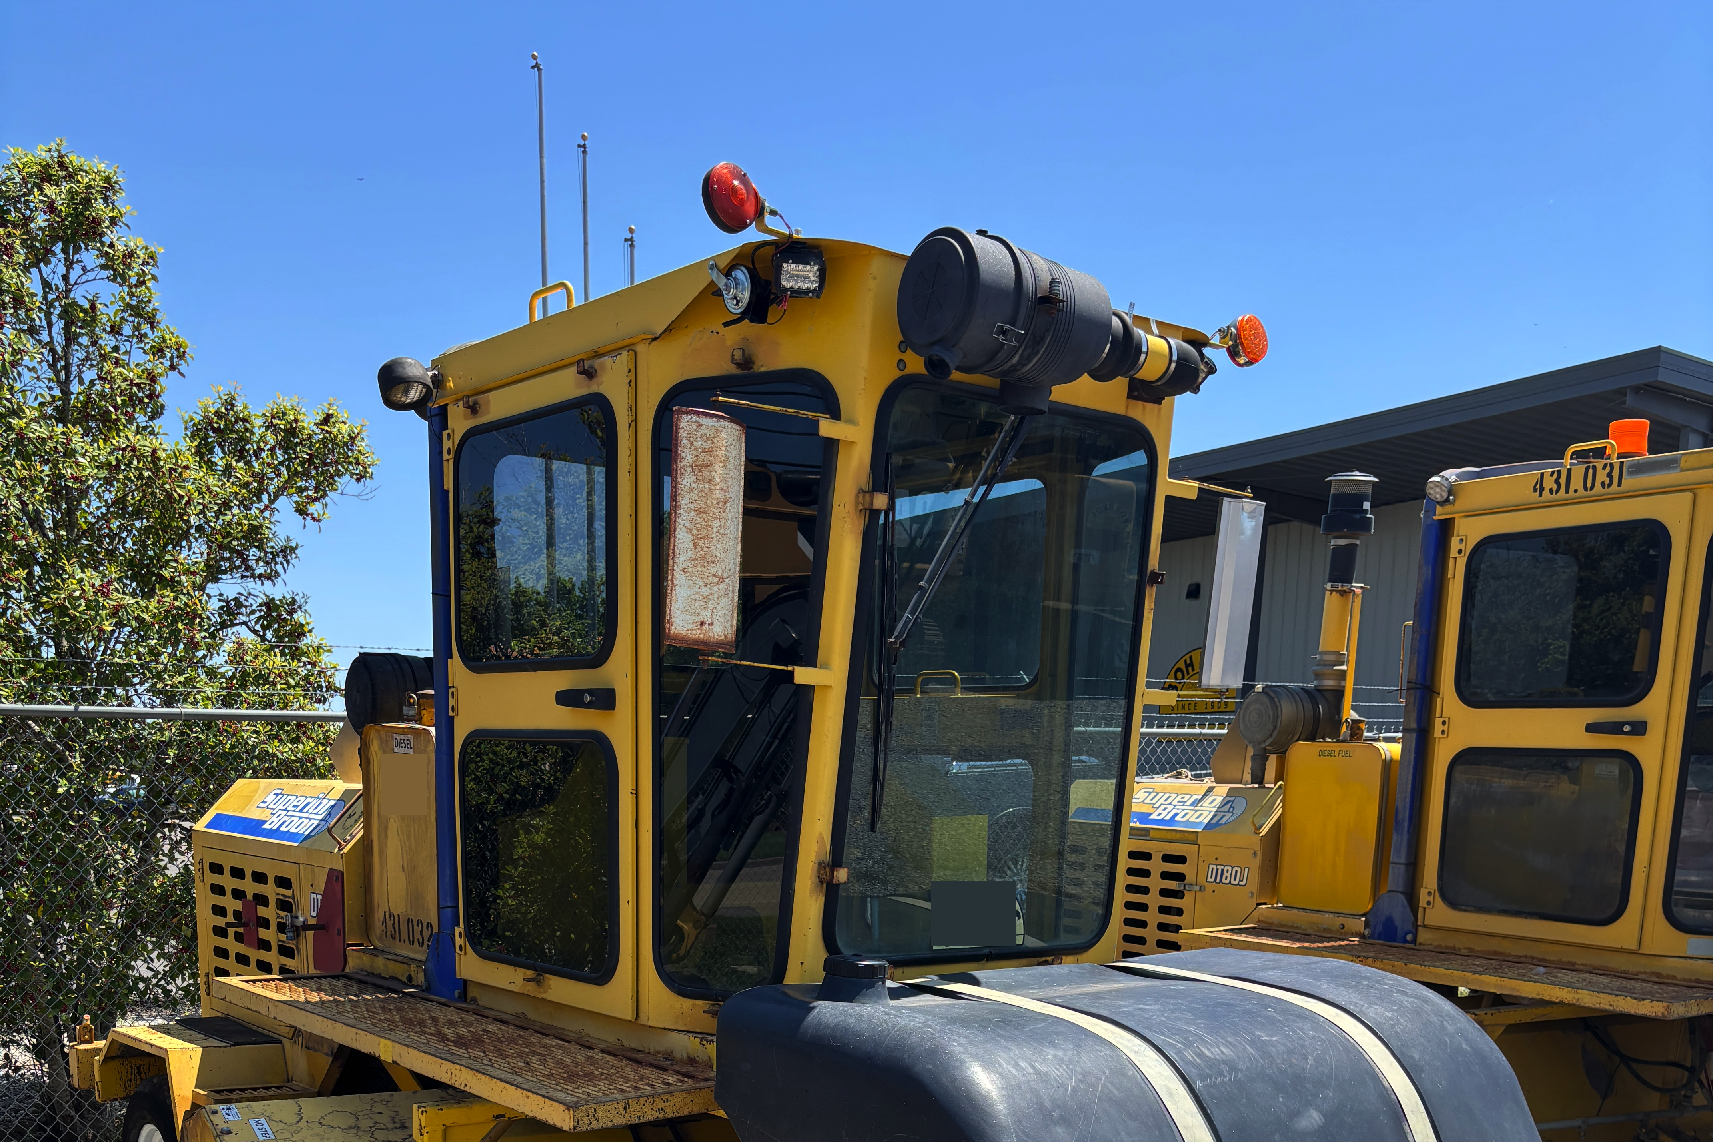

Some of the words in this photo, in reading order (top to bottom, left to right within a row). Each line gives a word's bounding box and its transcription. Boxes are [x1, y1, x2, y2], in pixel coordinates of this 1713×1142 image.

[1533, 461, 1624, 497] 431.031
[1205, 701, 1229, 710] 1909
[394, 737, 413, 750] DIESEL
[1318, 749, 1337, 758] DIESEL
[1338, 750, 1353, 758] FUEL
[256, 787, 337, 815] Superior
[1132, 787, 1233, 812] Superior
[262, 809, 329, 836] Broom
[1148, 804, 1232, 824] Broom
[1206, 863, 1250, 887] DT80J
